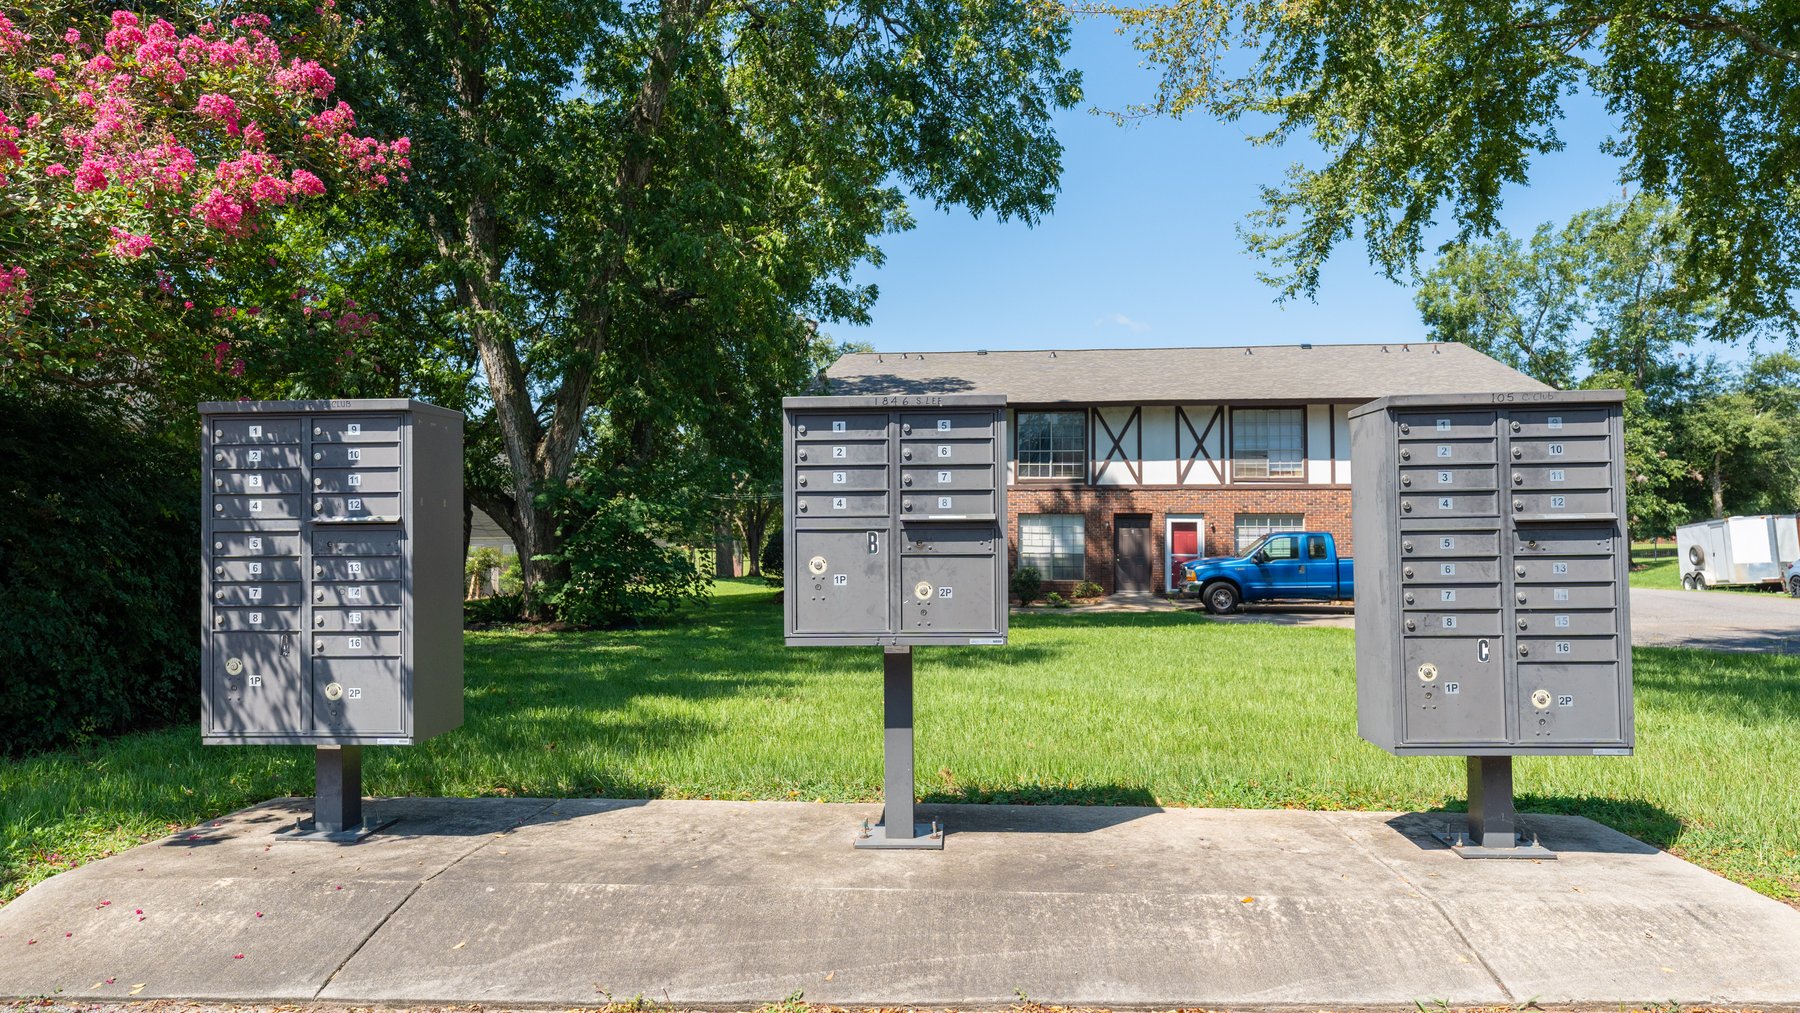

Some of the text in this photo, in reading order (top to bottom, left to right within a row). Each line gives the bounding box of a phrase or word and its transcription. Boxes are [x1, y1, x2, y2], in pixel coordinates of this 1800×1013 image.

[874, 396, 909, 406] 1846
[1492, 392, 1514, 402] 105
[331, 400, 352, 408] CLUB
[1550, 445, 1562, 454] 10
[349, 450, 359, 459] 10
[349, 476, 359, 484] 11
[1551, 471, 1562, 480] 11
[349, 500, 360, 509] 12
[1552, 497, 1564, 506] 12
[867, 531, 880, 555] B
[349, 563, 360, 572] 13
[1554, 564, 1566, 573] 13
[835, 575, 846, 584] 1P
[940, 588, 952, 597] 2P
[350, 639, 361, 648] 16
[1557, 643, 1569, 652] 16
[1476, 638, 1490, 663] C
[249, 676, 261, 685] 1P
[1446, 683, 1458, 692] 1P
[349, 689, 361, 698] 2P
[1559, 696, 1572, 706] 2P
